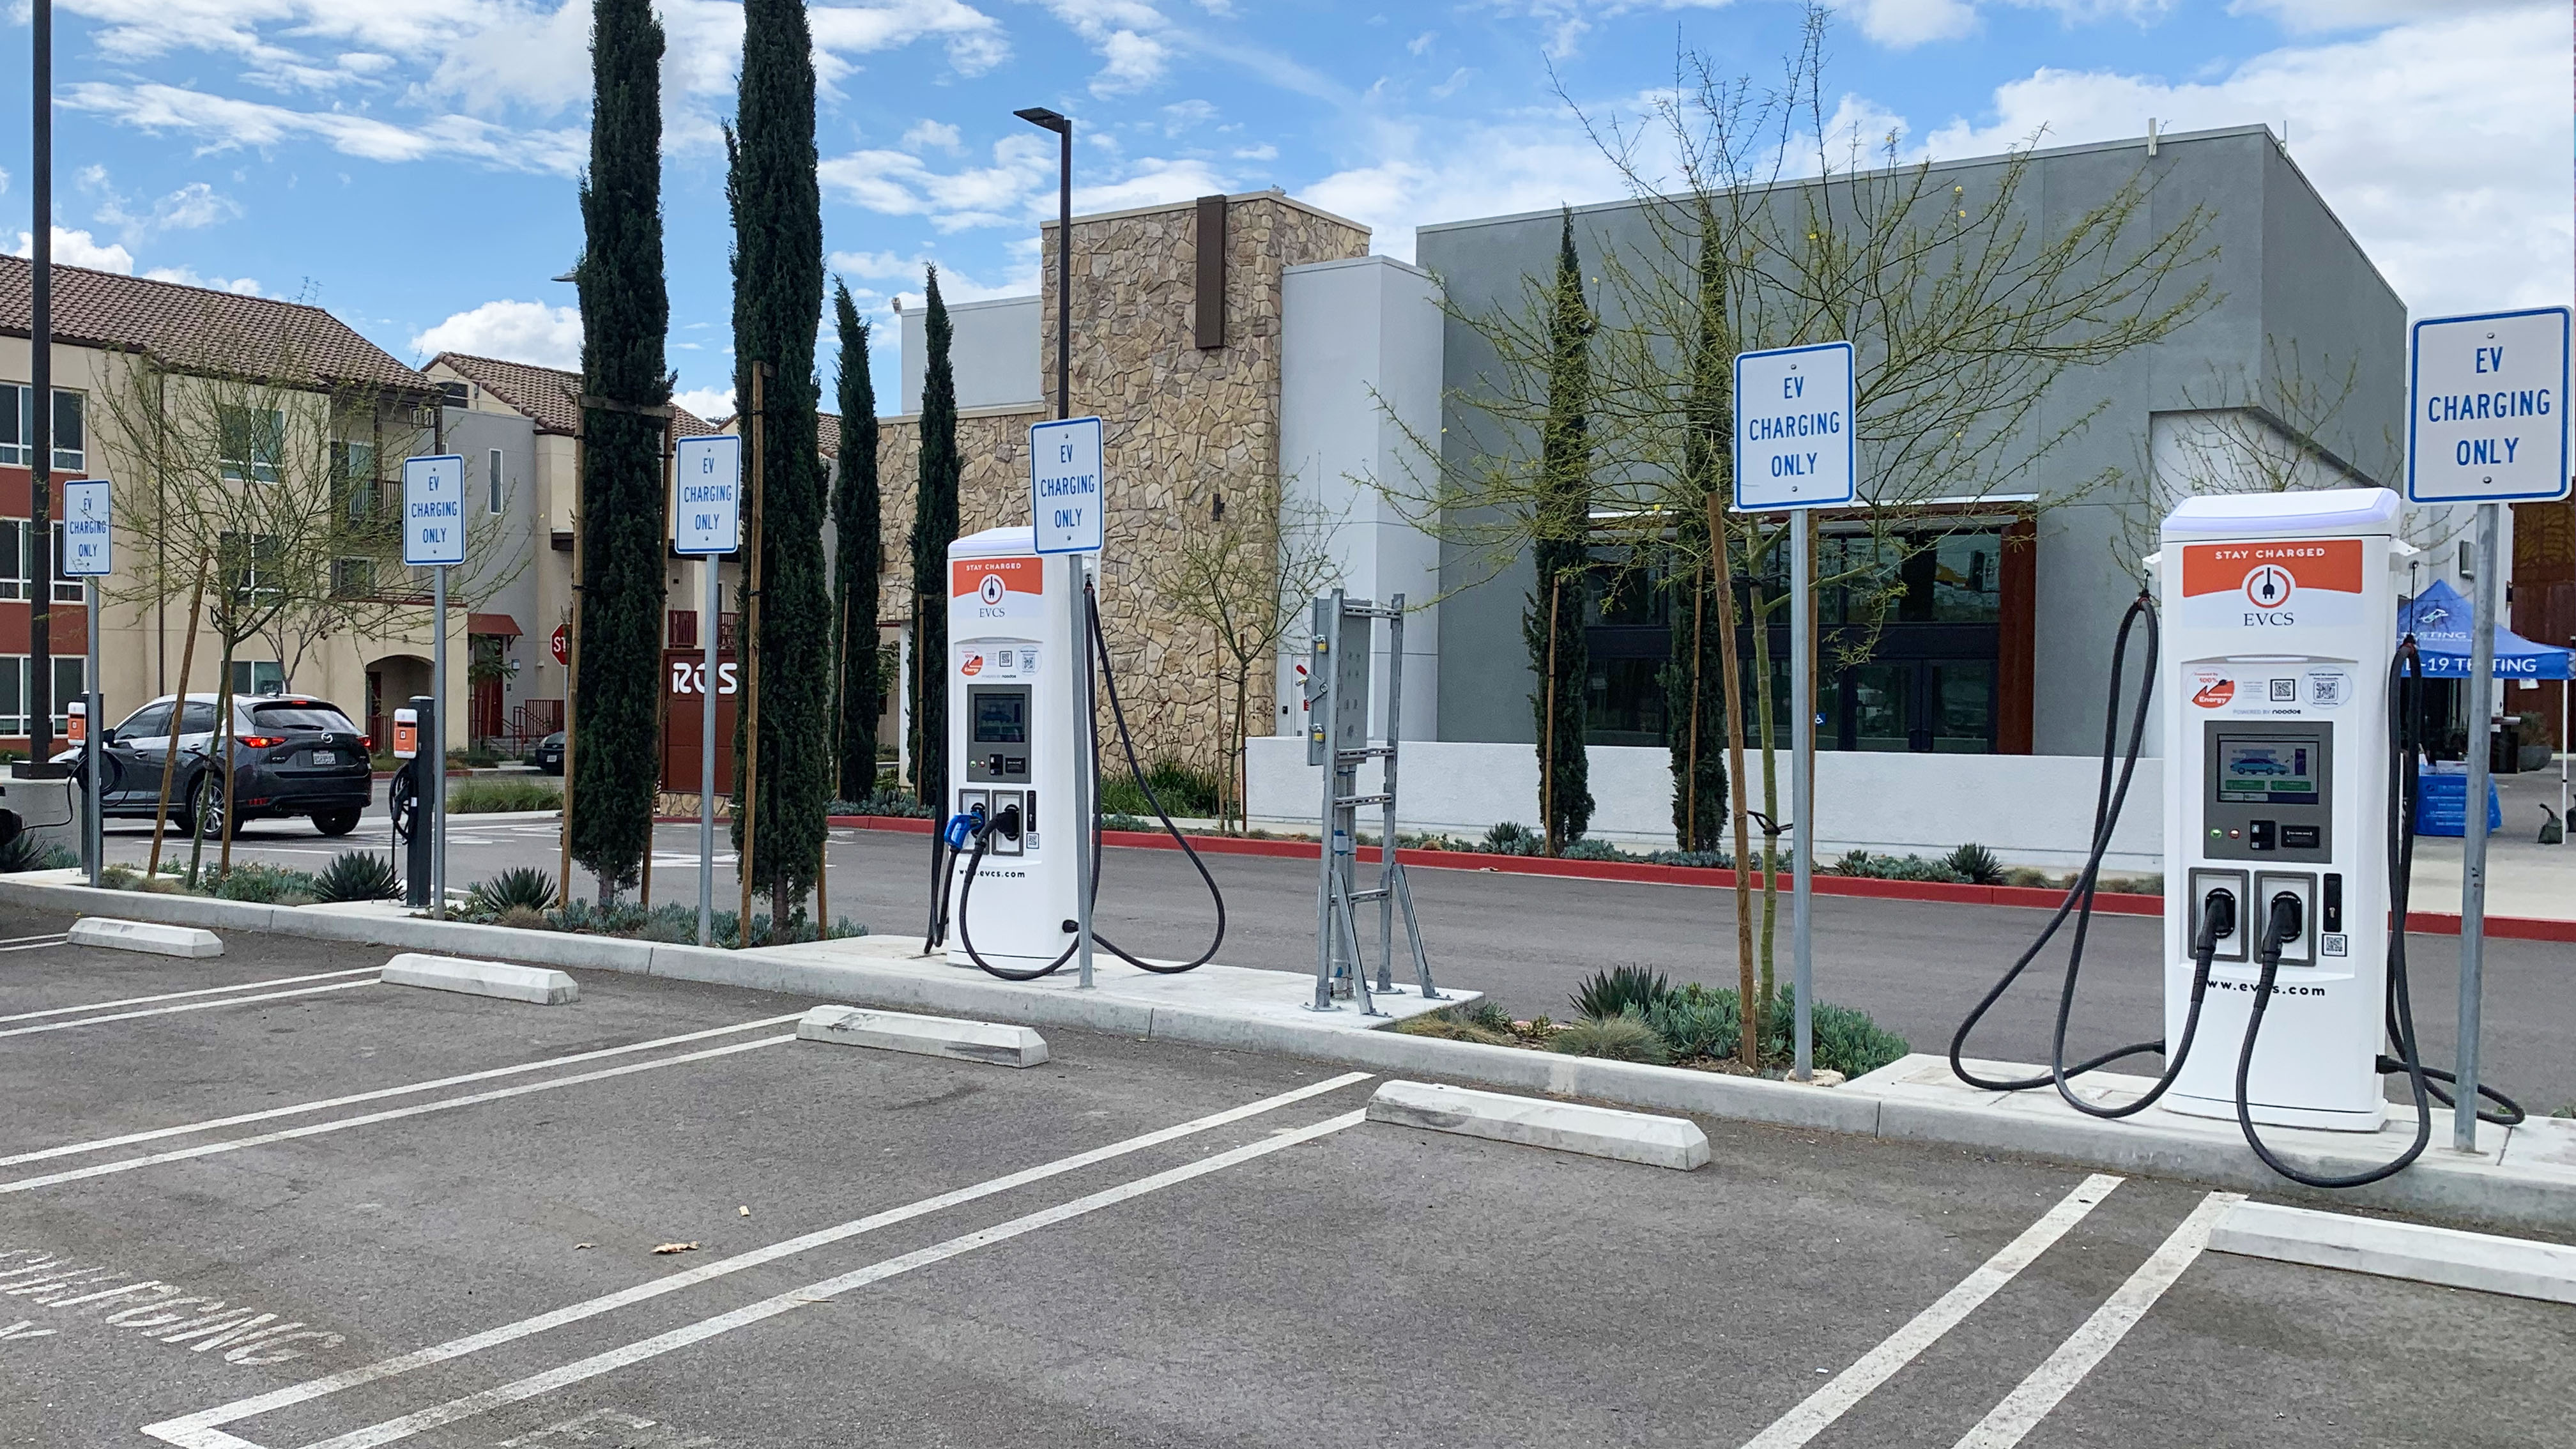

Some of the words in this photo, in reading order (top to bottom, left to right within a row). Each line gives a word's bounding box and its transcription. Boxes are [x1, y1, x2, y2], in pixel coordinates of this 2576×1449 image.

[2476, 346, 2503, 373] EV
[1784, 376, 1804, 399] EV
[2428, 388, 2550, 422] CHARGING
[1749, 411, 1840, 441] CHARGING
[1060, 444, 1073, 463] EV
[2456, 437, 2519, 466] ONLY
[703, 457, 714, 473] EV
[1771, 452, 1818, 477] ONLY
[429, 476, 440, 491] EV
[1040, 474, 1095, 497] CHARGING
[684, 485, 732, 503] CHARGING
[83, 498, 93, 511] EV
[411, 501, 457, 518] CHARGING
[695, 513, 720, 531] ONLY
[1054, 508, 1082, 528] ONLY
[69, 521, 107, 535] CHARGING
[422, 528, 447, 543] ONLY
[78, 544, 98, 557] ONLY
[2215, 550, 2249, 560] STAY
[2255, 548, 2326, 558] CHARGED
[979, 608, 1005, 618] EVCS
[2243, 612, 2294, 626] EVCS
[553, 636, 566, 653] ST
[2454, 657, 2537, 671] TETING
[2198, 696, 2227, 704] Energy
[2206, 979, 2326, 997] ww.evs.com
